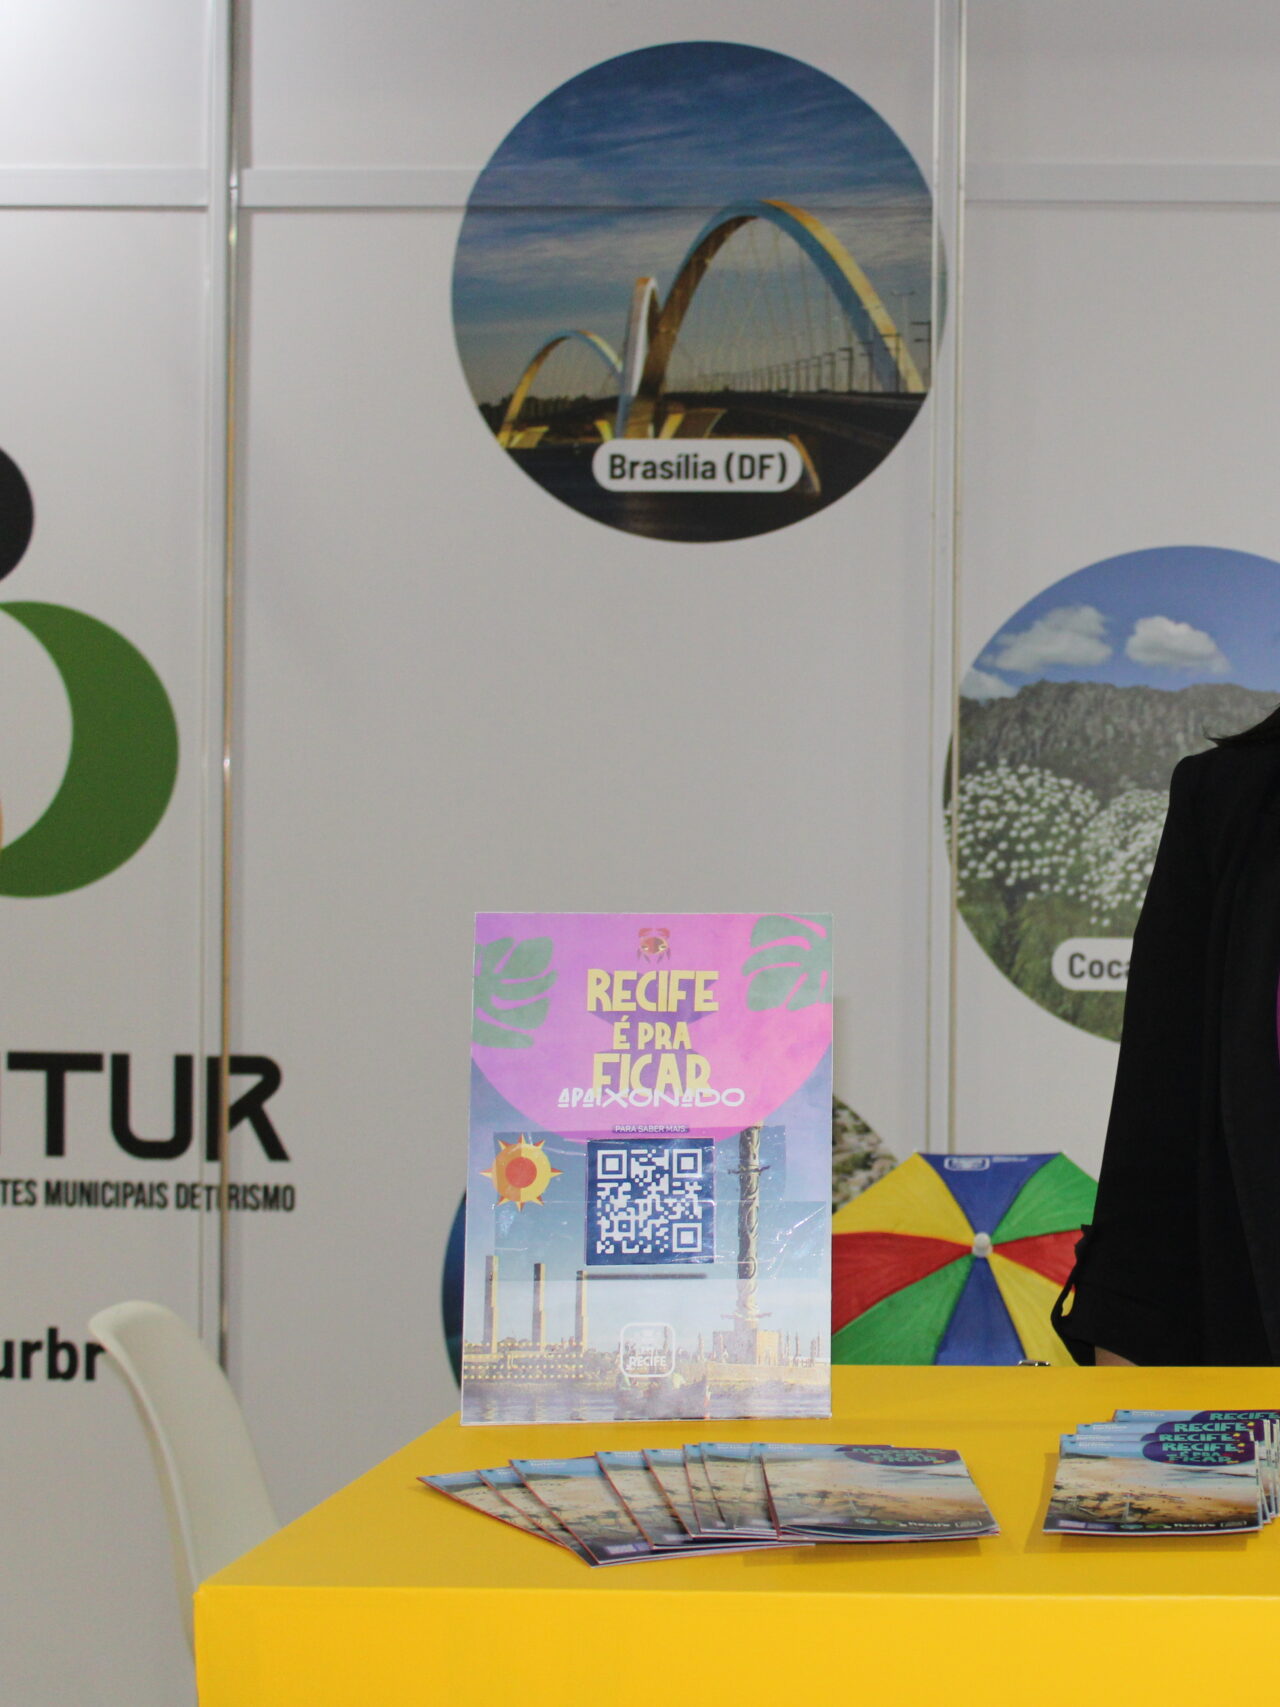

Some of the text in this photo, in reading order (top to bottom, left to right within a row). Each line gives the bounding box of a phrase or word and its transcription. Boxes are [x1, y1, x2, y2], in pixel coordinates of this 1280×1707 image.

[608, 452, 788, 482] Brasília (DF)
[1068, 952, 1131, 979] Coc
[587, 968, 720, 1012] RECIFE
[613, 1015, 692, 1050] É PRA
[593, 1053, 714, 1097] FICAR
[7, 1052, 290, 1161] TUR
[558, 1087, 746, 1108] APAIXONADO
[639, 1125, 665, 1133] SABER
[45, 1179, 168, 1209] MUNICIPAIS
[175, 1182, 201, 1209] DE
[1174, 1423, 1250, 1432] RECIFE
[1162, 1442, 1241, 1451] RECIFE
